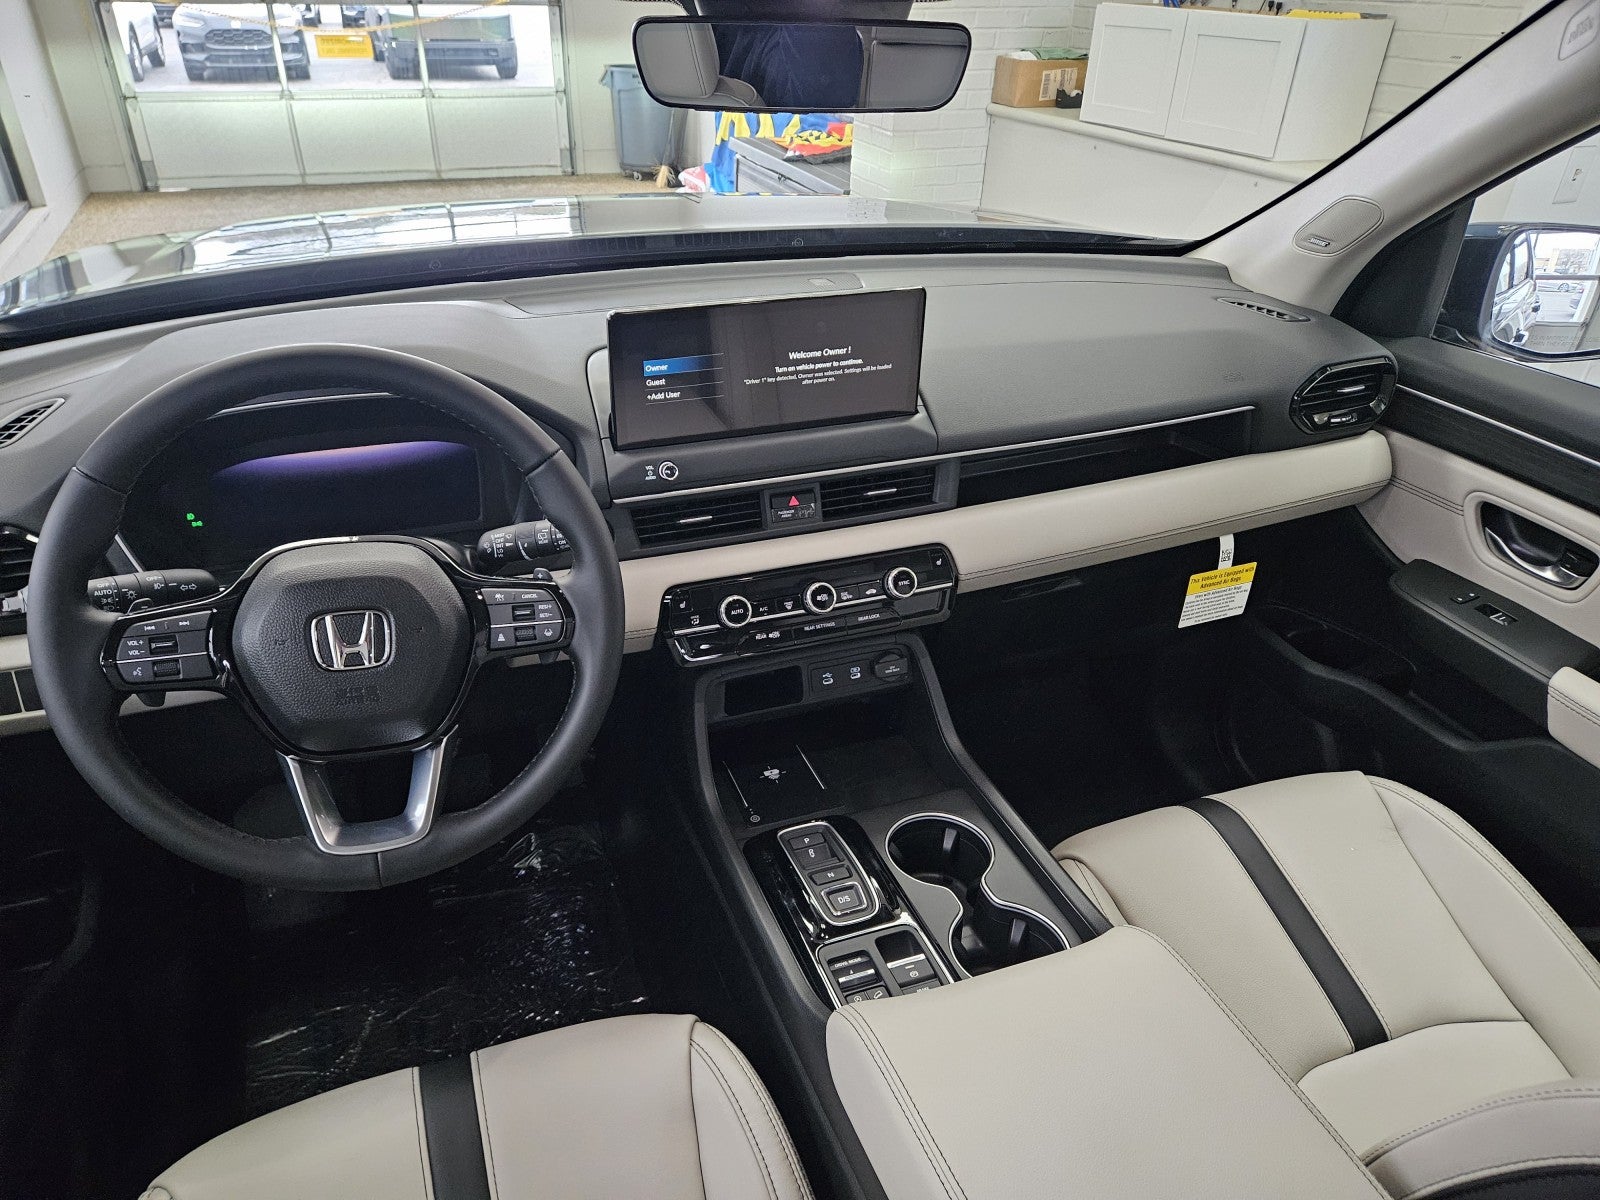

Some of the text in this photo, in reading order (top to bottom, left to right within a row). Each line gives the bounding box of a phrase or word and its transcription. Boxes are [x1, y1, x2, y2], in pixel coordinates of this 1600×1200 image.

[788, 350, 822, 360] Welcome
[823, 348, 847, 356] Owner
[645, 364, 668, 372] Owner
[796, 363, 815, 371] vehicle
[815, 362, 832, 370] power
[646, 378, 666, 386] Guest
[647, 391, 681, 401] +Add User
[1201, 574, 1218, 582] Vehicle
[1224, 569, 1244, 578] Equipped
[1200, 580, 1222, 590] Advanced
[816, 621, 836, 629] SETTINGS
[837, 895, 851, 904] D/S
